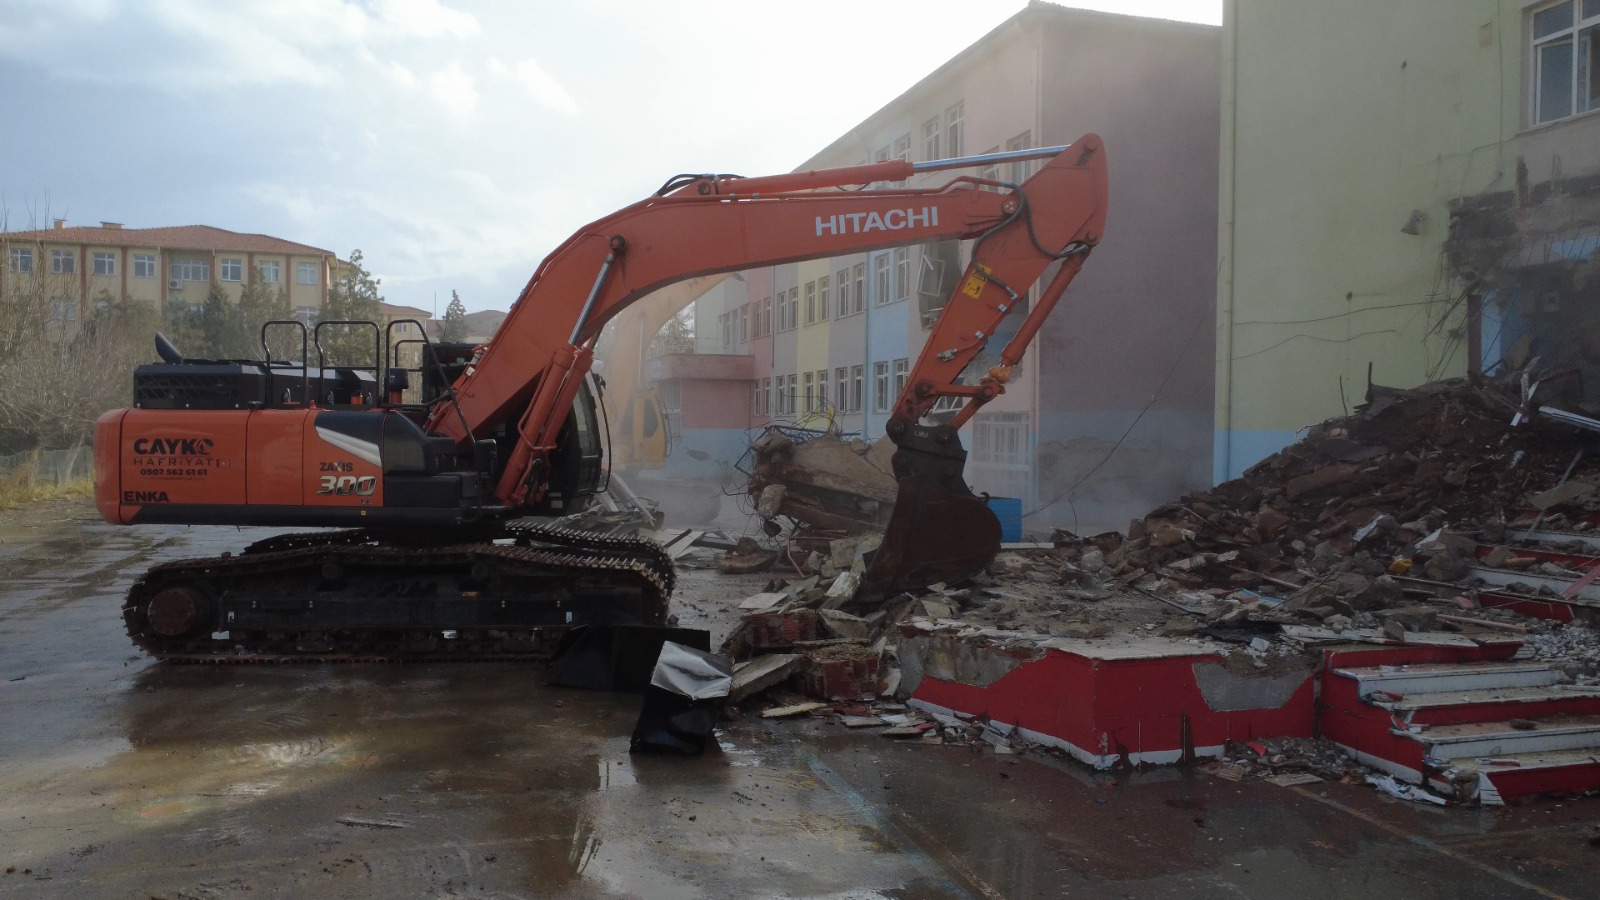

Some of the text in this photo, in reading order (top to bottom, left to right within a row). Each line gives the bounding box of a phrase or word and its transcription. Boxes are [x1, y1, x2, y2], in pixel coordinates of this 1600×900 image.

[815, 206, 938, 236] HITACHI
[140, 468, 208, 476] 0507 562 61 61
[320, 460, 353, 472] ZAXIS
[317, 475, 377, 496] 300
[123, 491, 169, 502] ENKA
